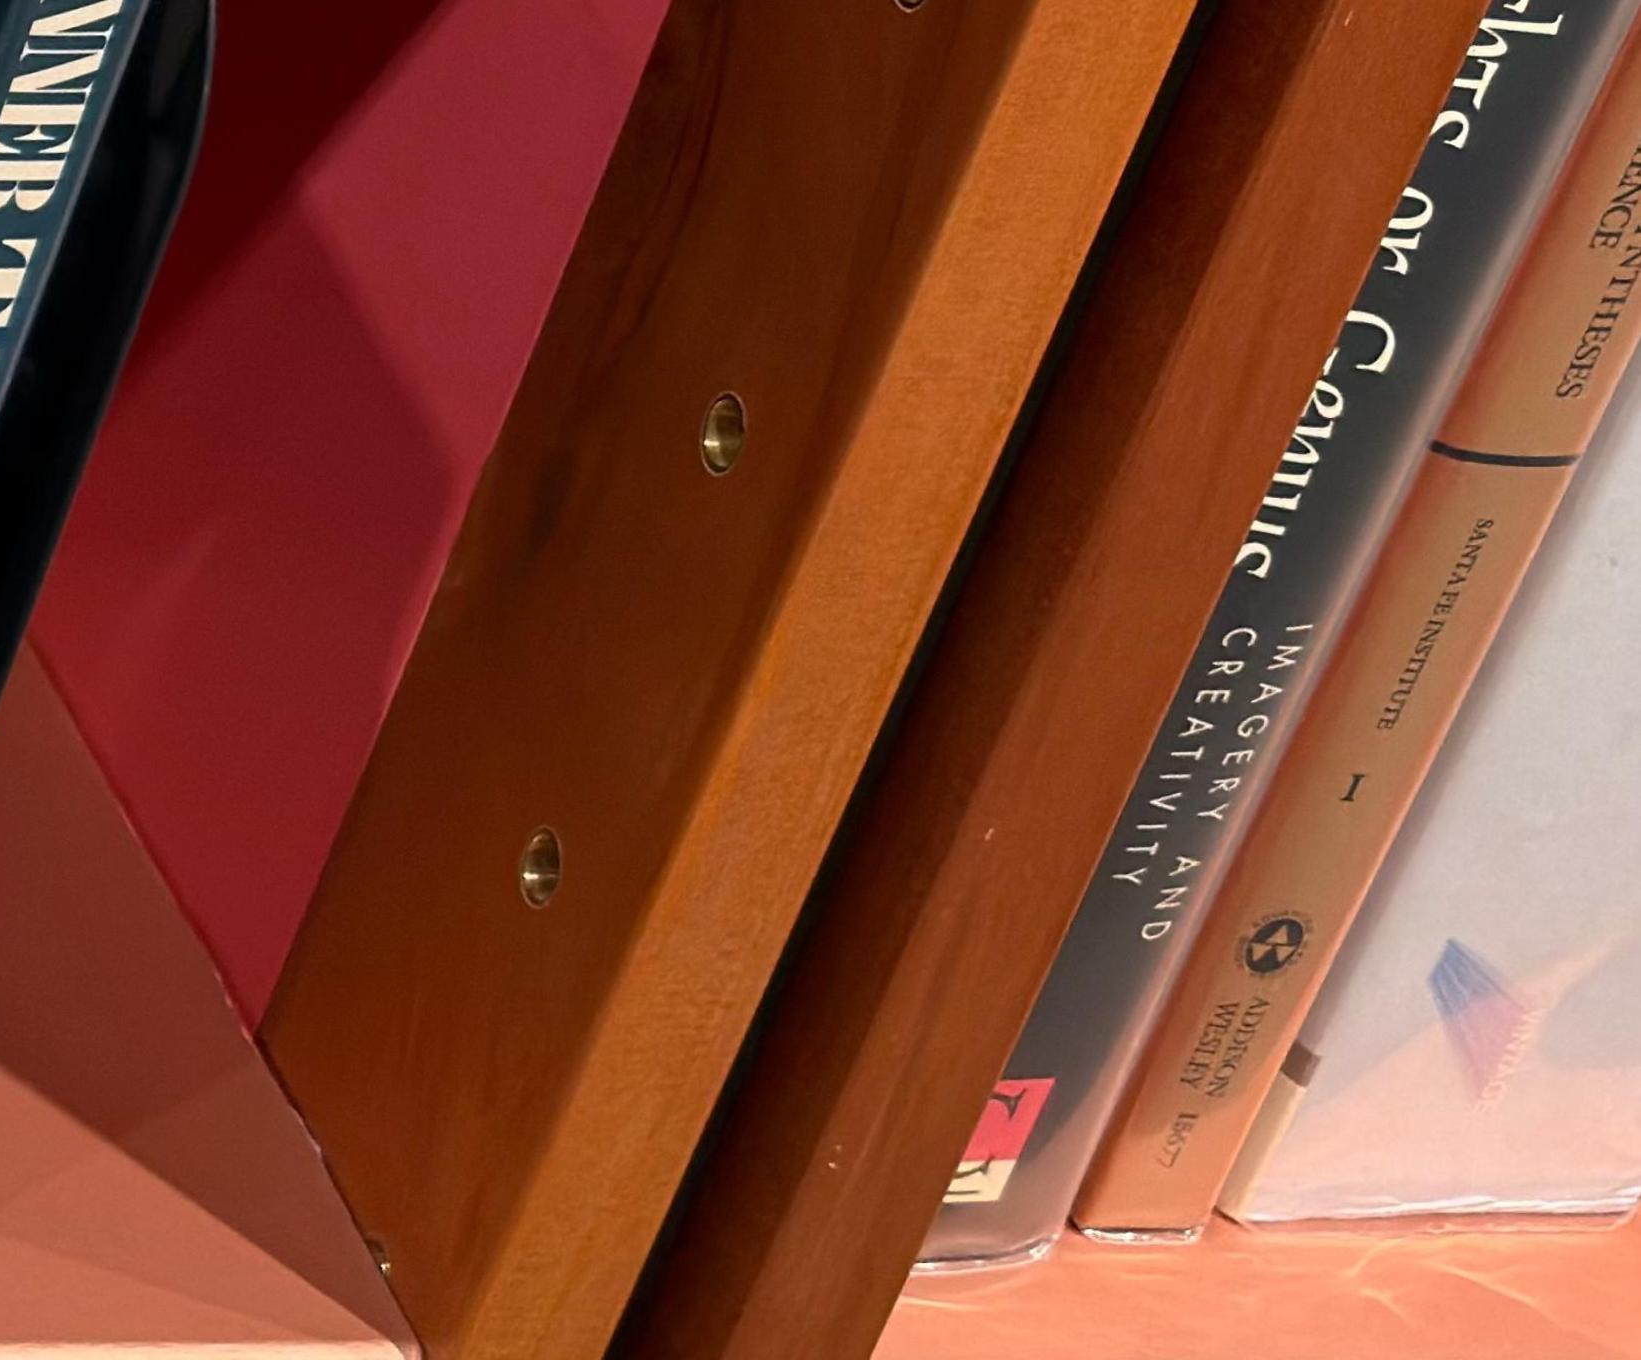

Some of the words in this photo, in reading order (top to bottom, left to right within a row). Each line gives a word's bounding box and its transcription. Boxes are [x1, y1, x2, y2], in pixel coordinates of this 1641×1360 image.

[1447, 516, 1496, 588] SANTA
[1197, 623, 1315, 824] IMAGERY
[1376, 616, 1445, 731] INSTITUTE
[1113, 626, 1258, 888] CREATIVITY
[1141, 854, 1201, 942] AND
[1180, 1002, 1239, 1089] WESLEY
